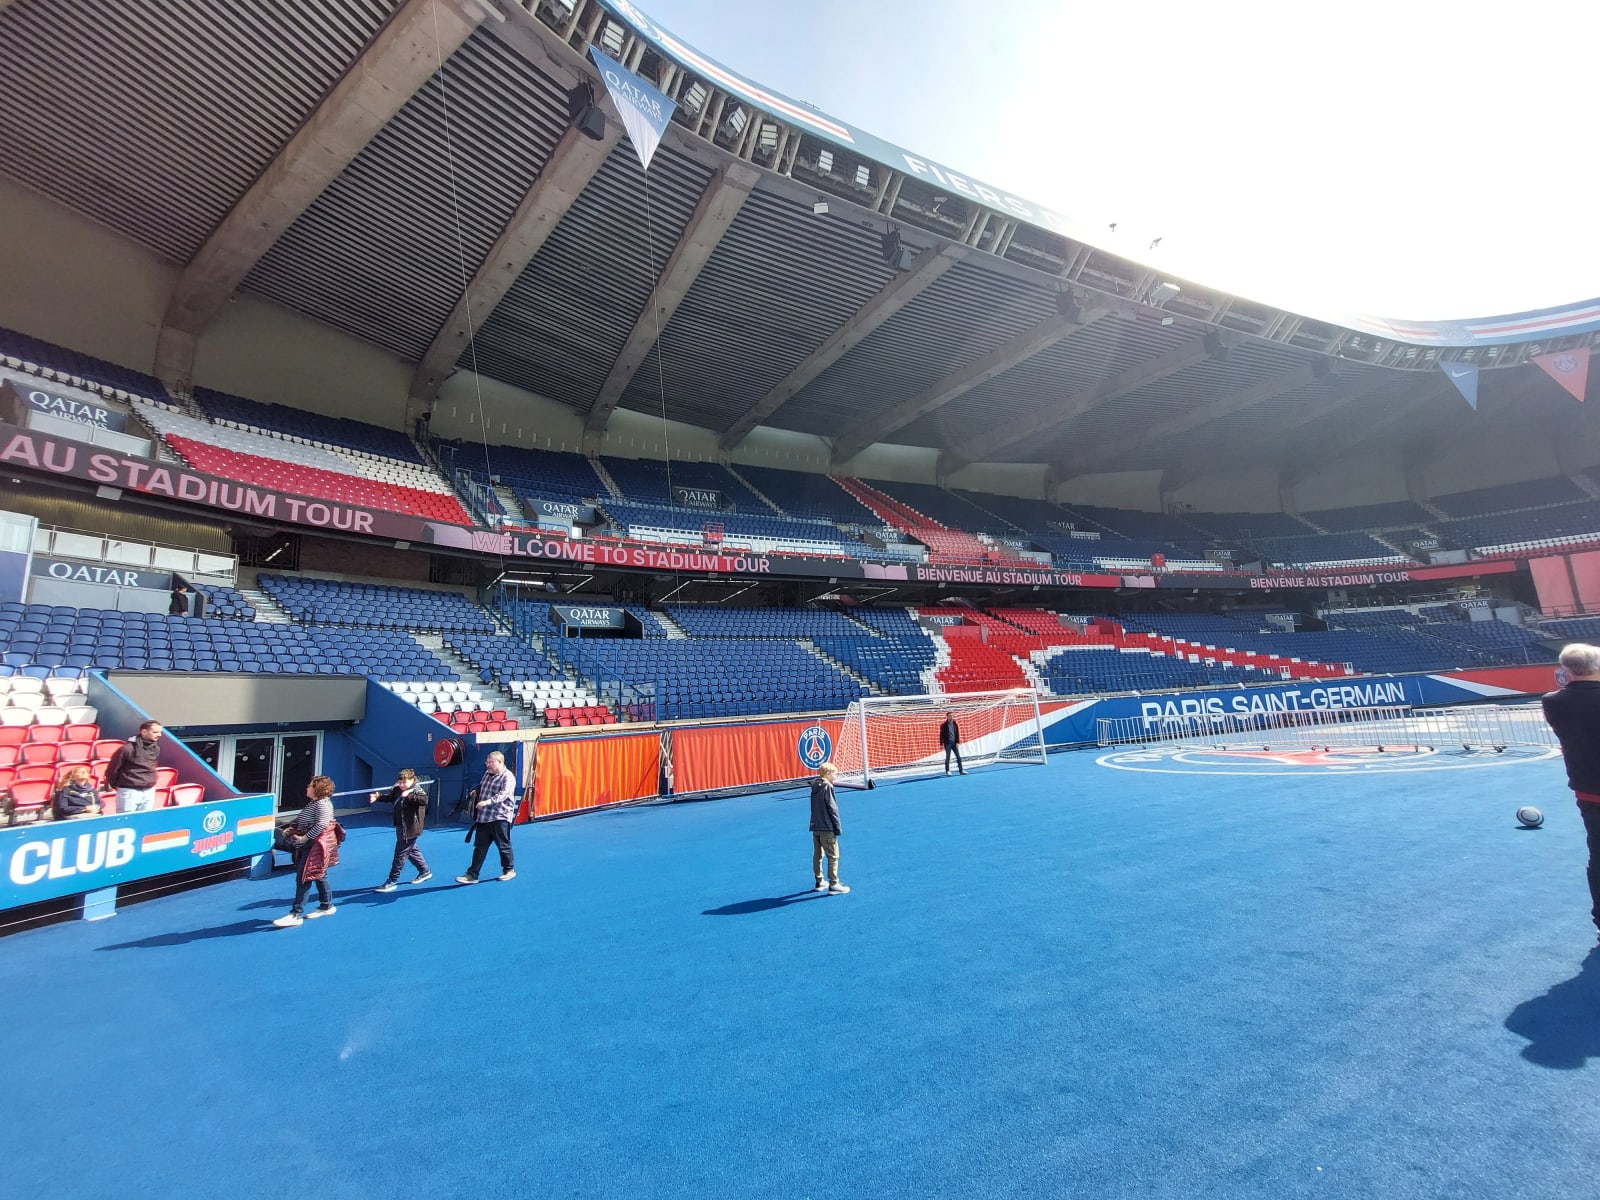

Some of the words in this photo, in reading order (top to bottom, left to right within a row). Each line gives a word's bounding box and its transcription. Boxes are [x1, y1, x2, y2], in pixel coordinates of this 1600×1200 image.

[605, 70, 661, 113] QATAR
[902, 153, 1033, 218] FIERS
[29, 391, 108, 423] QATAR
[50, 409, 108, 431] AIRWAYS
[0, 434, 76, 473] AU
[88, 454, 277, 518] STADIUM
[286, 498, 374, 533] TOUR
[679, 489, 717, 502] QATAR
[543, 502, 578, 515] QATAR
[552, 511, 579, 521] AIRWAYS
[875, 531, 898, 540] QATAR
[1413, 539, 1438, 548] QATAR
[472, 531, 595, 562] WELCOME
[600, 545, 628, 564] TO
[632, 549, 719, 571] STADIUM
[723, 556, 770, 573] TOUR
[49, 562, 138, 587] QATAR
[916, 567, 983, 583] BIENVENUE
[985, 571, 1000, 583] AU
[1002, 571, 1052, 585] STADIUM
[1053, 573, 1082, 585] TOUR
[1250, 577, 1305, 589] BIENVENUE
[1306, 577, 1320, 588] AU
[1321, 574, 1375, 587] STADIUM
[1376, 571, 1409, 583] TOUR
[1460, 600, 1489, 609] QATAR
[570, 608, 610, 620] QATAR
[929, 616, 954, 625] QATAR
[1141, 697, 1224, 729] PARIS
[1232, 682, 1405, 720] SAINT-GERMAIN
[803, 728, 825, 740] PARIS
[10, 828, 136, 885] CLUB
